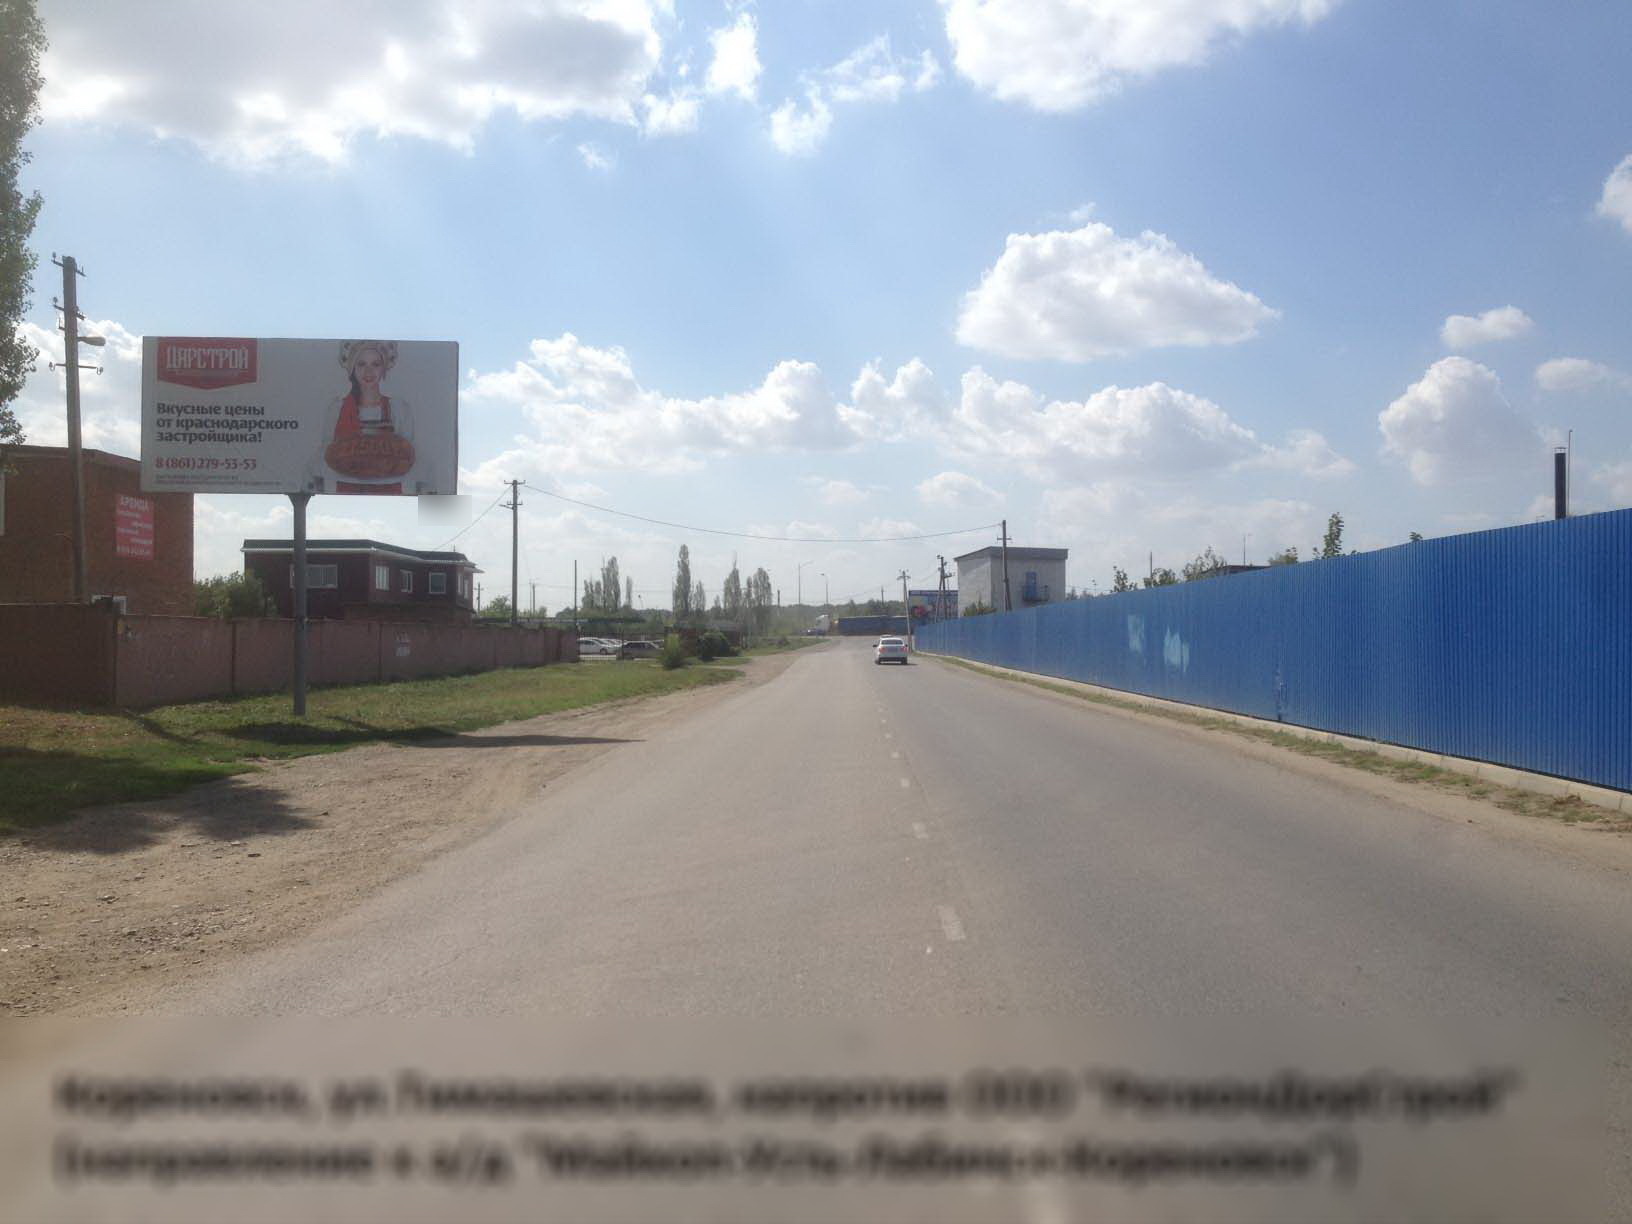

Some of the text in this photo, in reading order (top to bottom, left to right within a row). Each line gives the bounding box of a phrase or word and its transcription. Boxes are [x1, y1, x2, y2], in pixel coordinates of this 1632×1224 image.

[156, 402, 265, 417] Вкусные цены
[156, 418, 299, 432] от краснодарского
[155, 429, 263, 444] застройщика!
